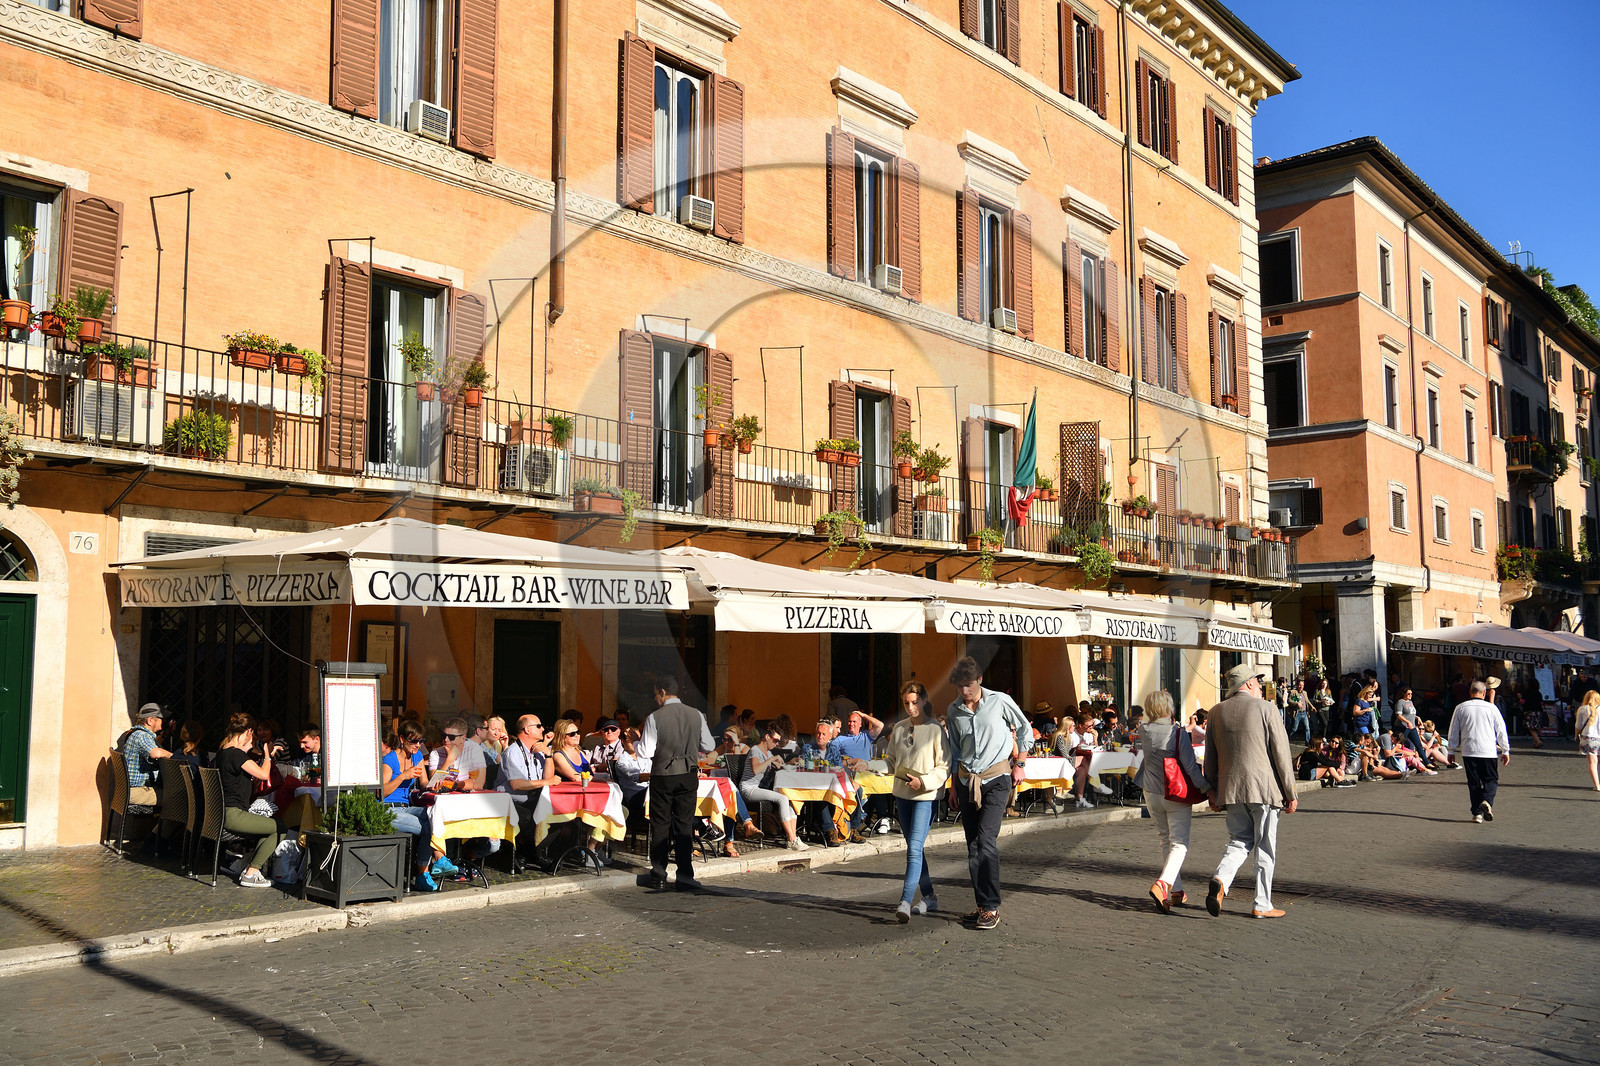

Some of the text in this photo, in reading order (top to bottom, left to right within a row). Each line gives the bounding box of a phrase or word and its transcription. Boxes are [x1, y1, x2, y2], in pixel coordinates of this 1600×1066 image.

[74, 535, 95, 551] 76
[124, 573, 235, 603] RISTORANTE
[246, 571, 341, 603] PIZZERIA
[368, 571, 506, 603] COCKTAIL
[635, 579, 672, 607] BAR
[784, 605, 874, 632] PIZZERIA
[949, 609, 1063, 636] CAFFÈ BAROCCO
[1105, 618, 1178, 643] RISTORANTE
[1392, 639, 1469, 656] CAFFETTERIA
[1471, 646, 1551, 665] PASTICCERIA
